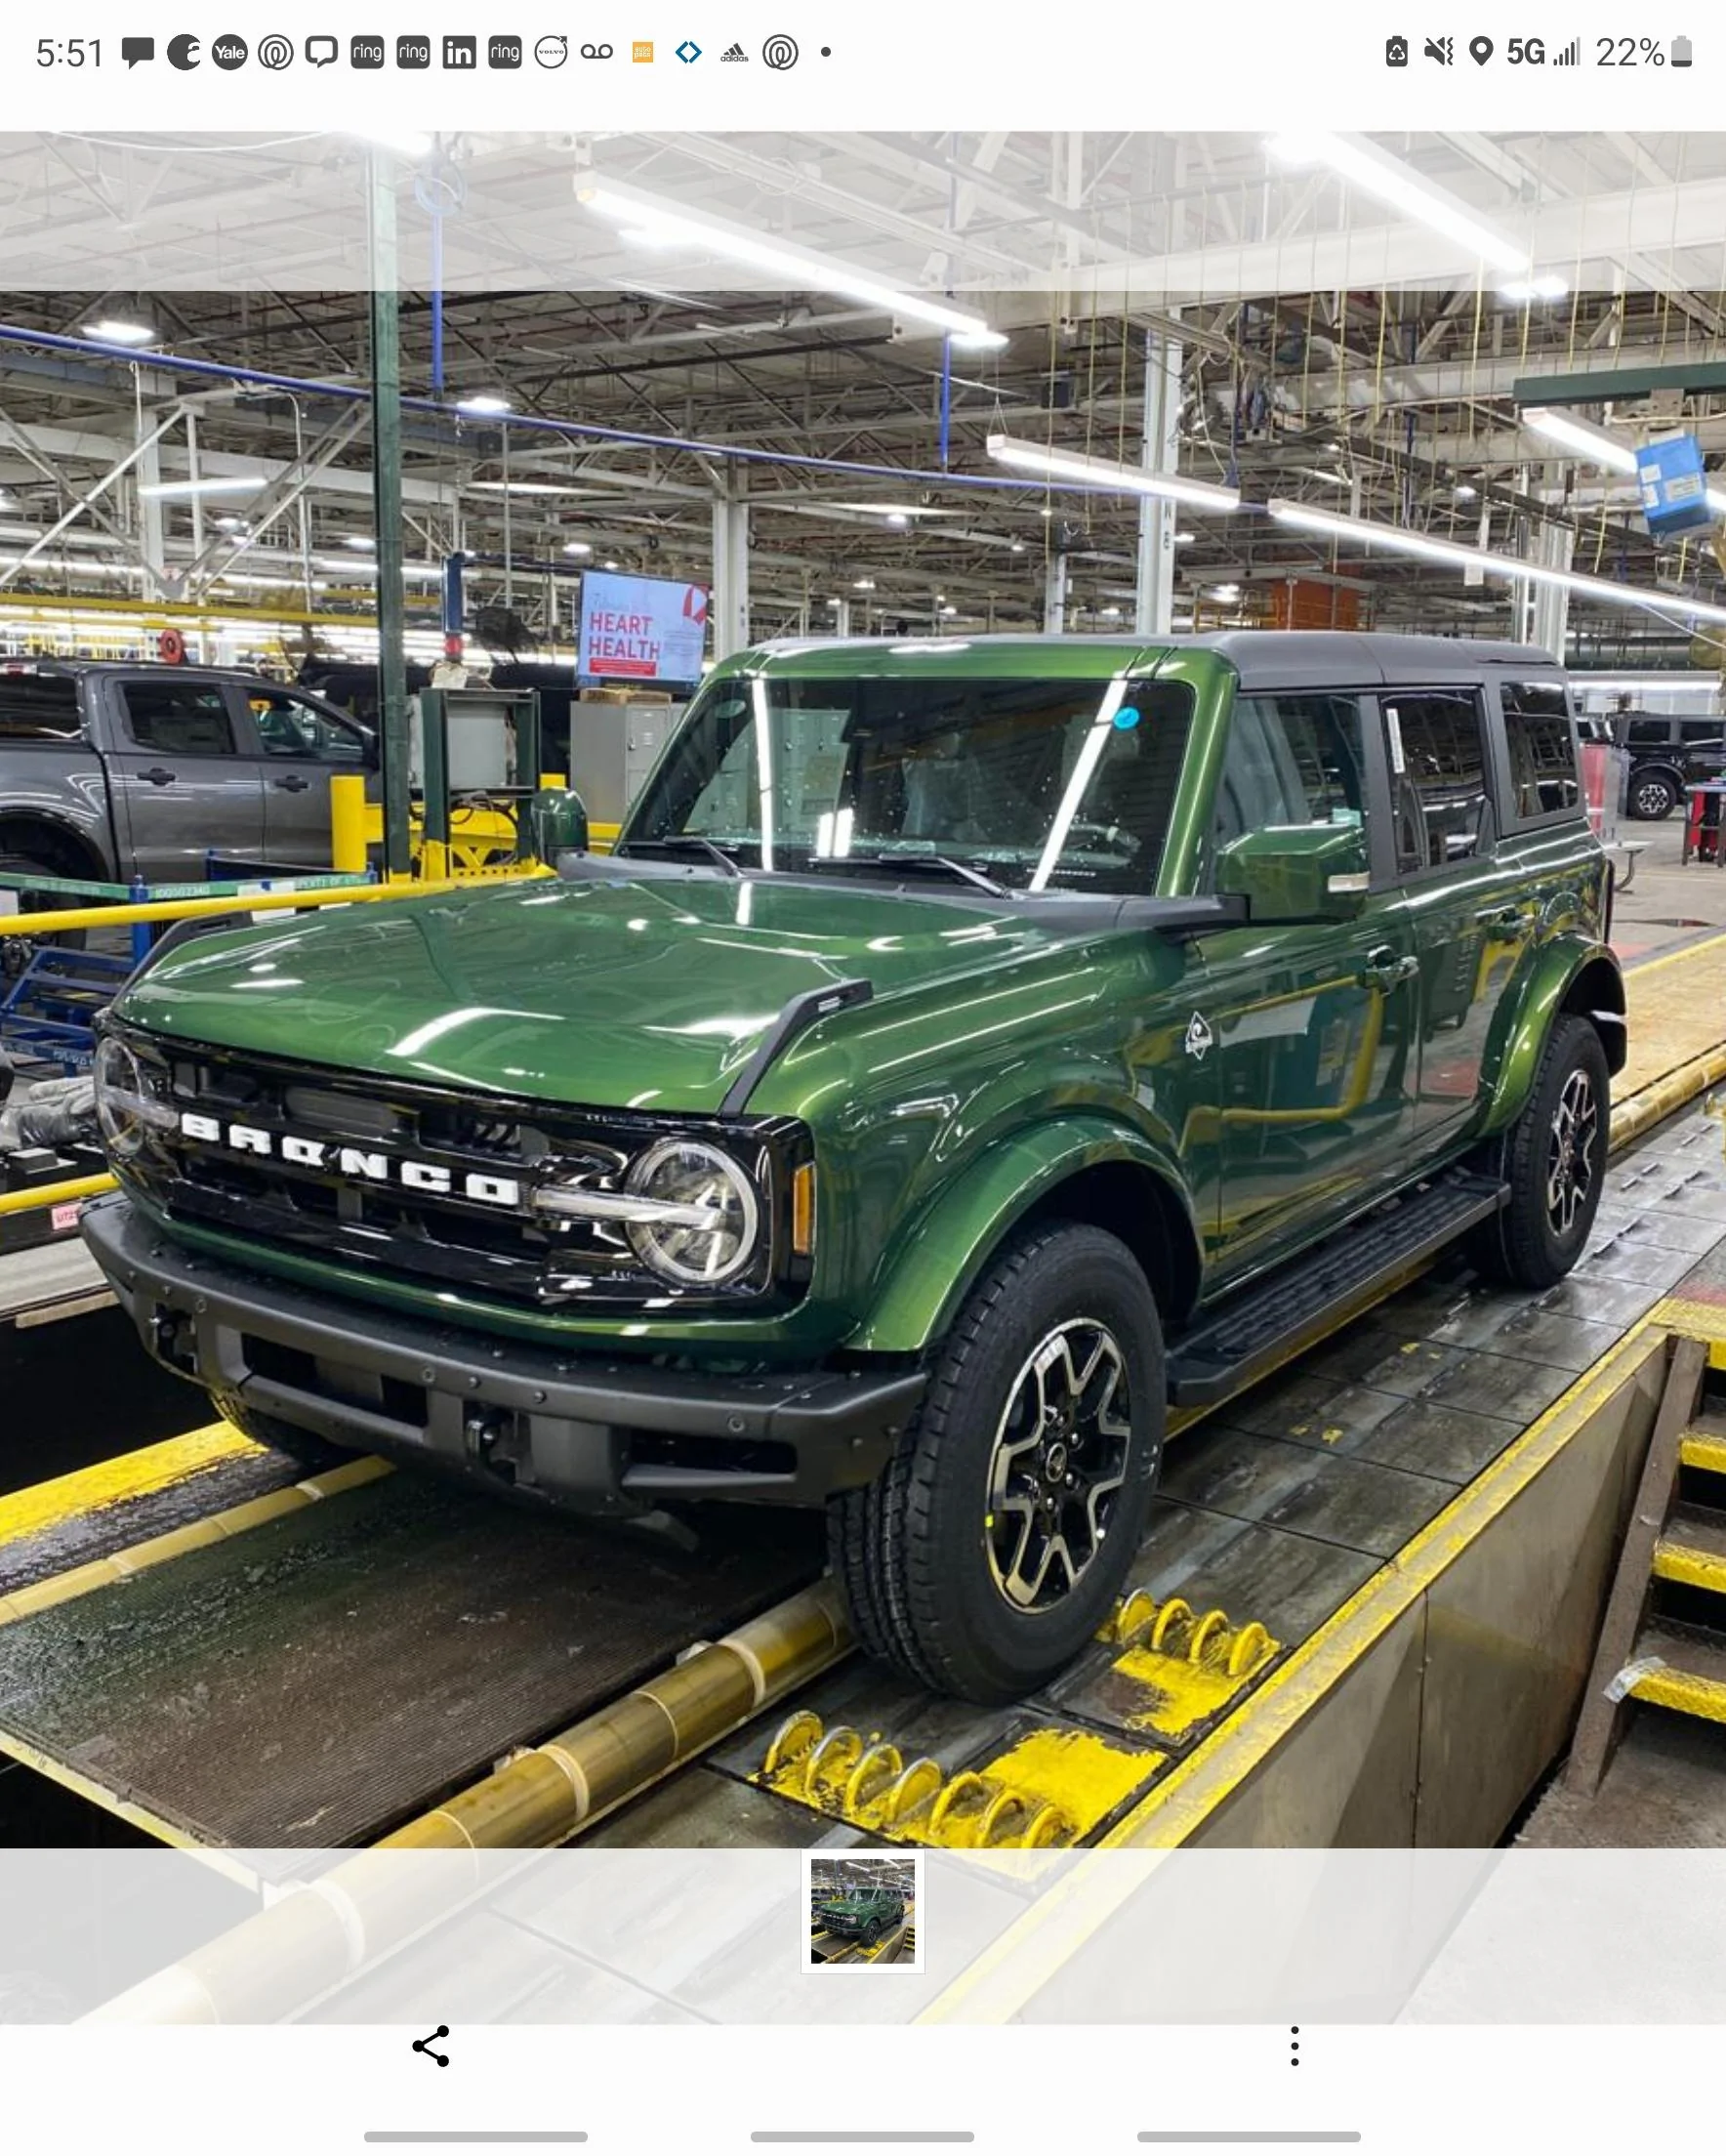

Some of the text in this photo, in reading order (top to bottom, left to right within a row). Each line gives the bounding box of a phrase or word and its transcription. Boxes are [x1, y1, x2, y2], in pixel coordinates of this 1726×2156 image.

[590, 611, 653, 636] HEART
[589, 636, 661, 661] HEALTH
[181, 1112, 519, 1206] BRONCO
